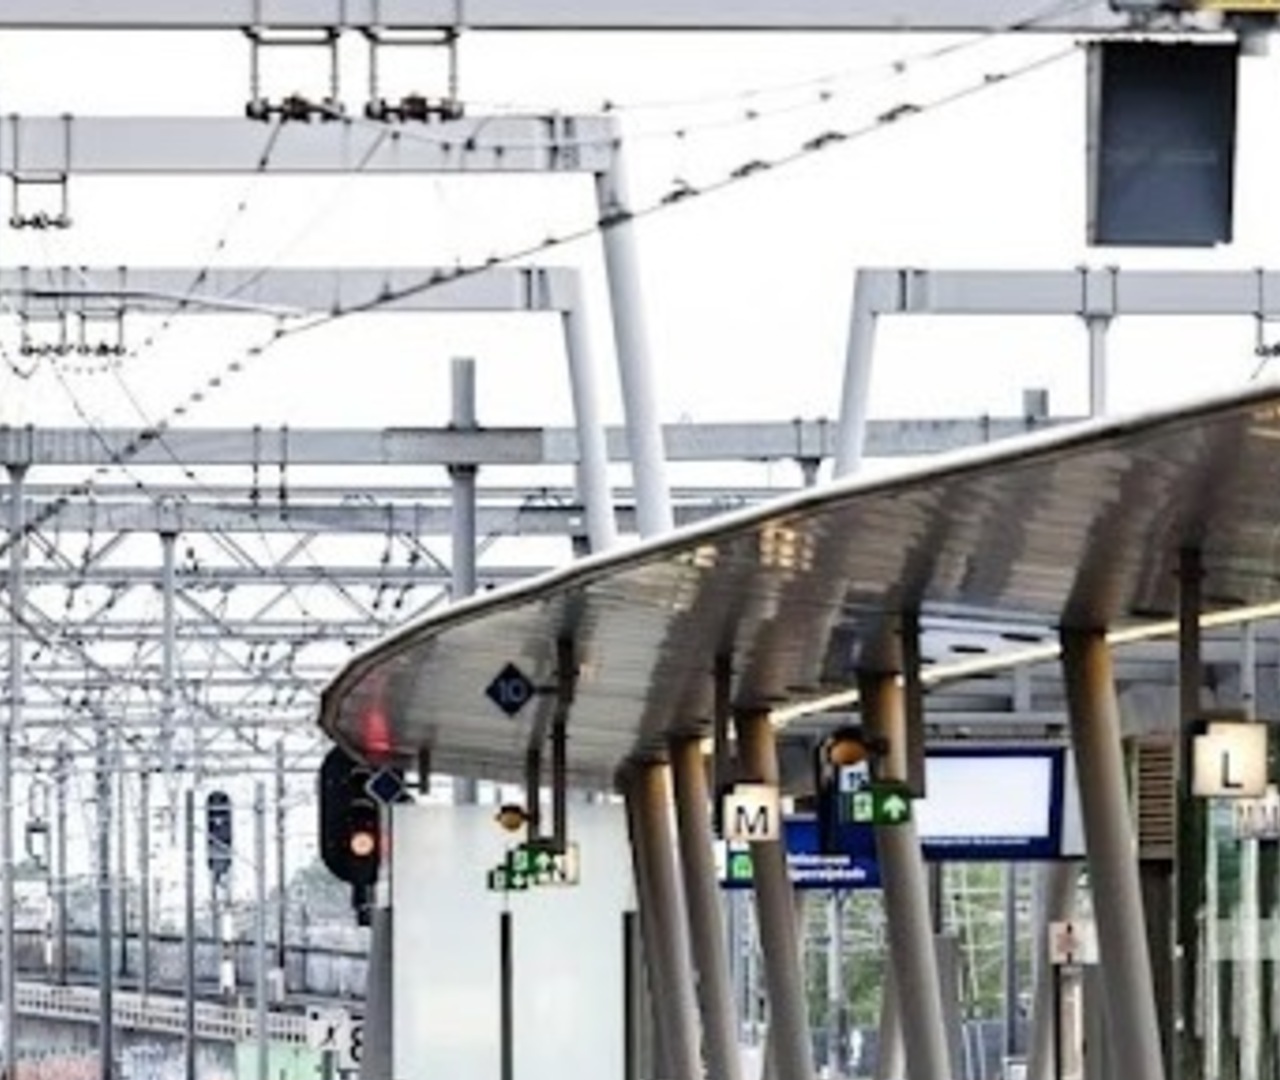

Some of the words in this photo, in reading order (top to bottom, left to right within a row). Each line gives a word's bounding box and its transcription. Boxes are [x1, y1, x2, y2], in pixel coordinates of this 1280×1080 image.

[500, 680, 528, 702] 10
[1222, 751, 1243, 788] L
[737, 805, 769, 835] M
